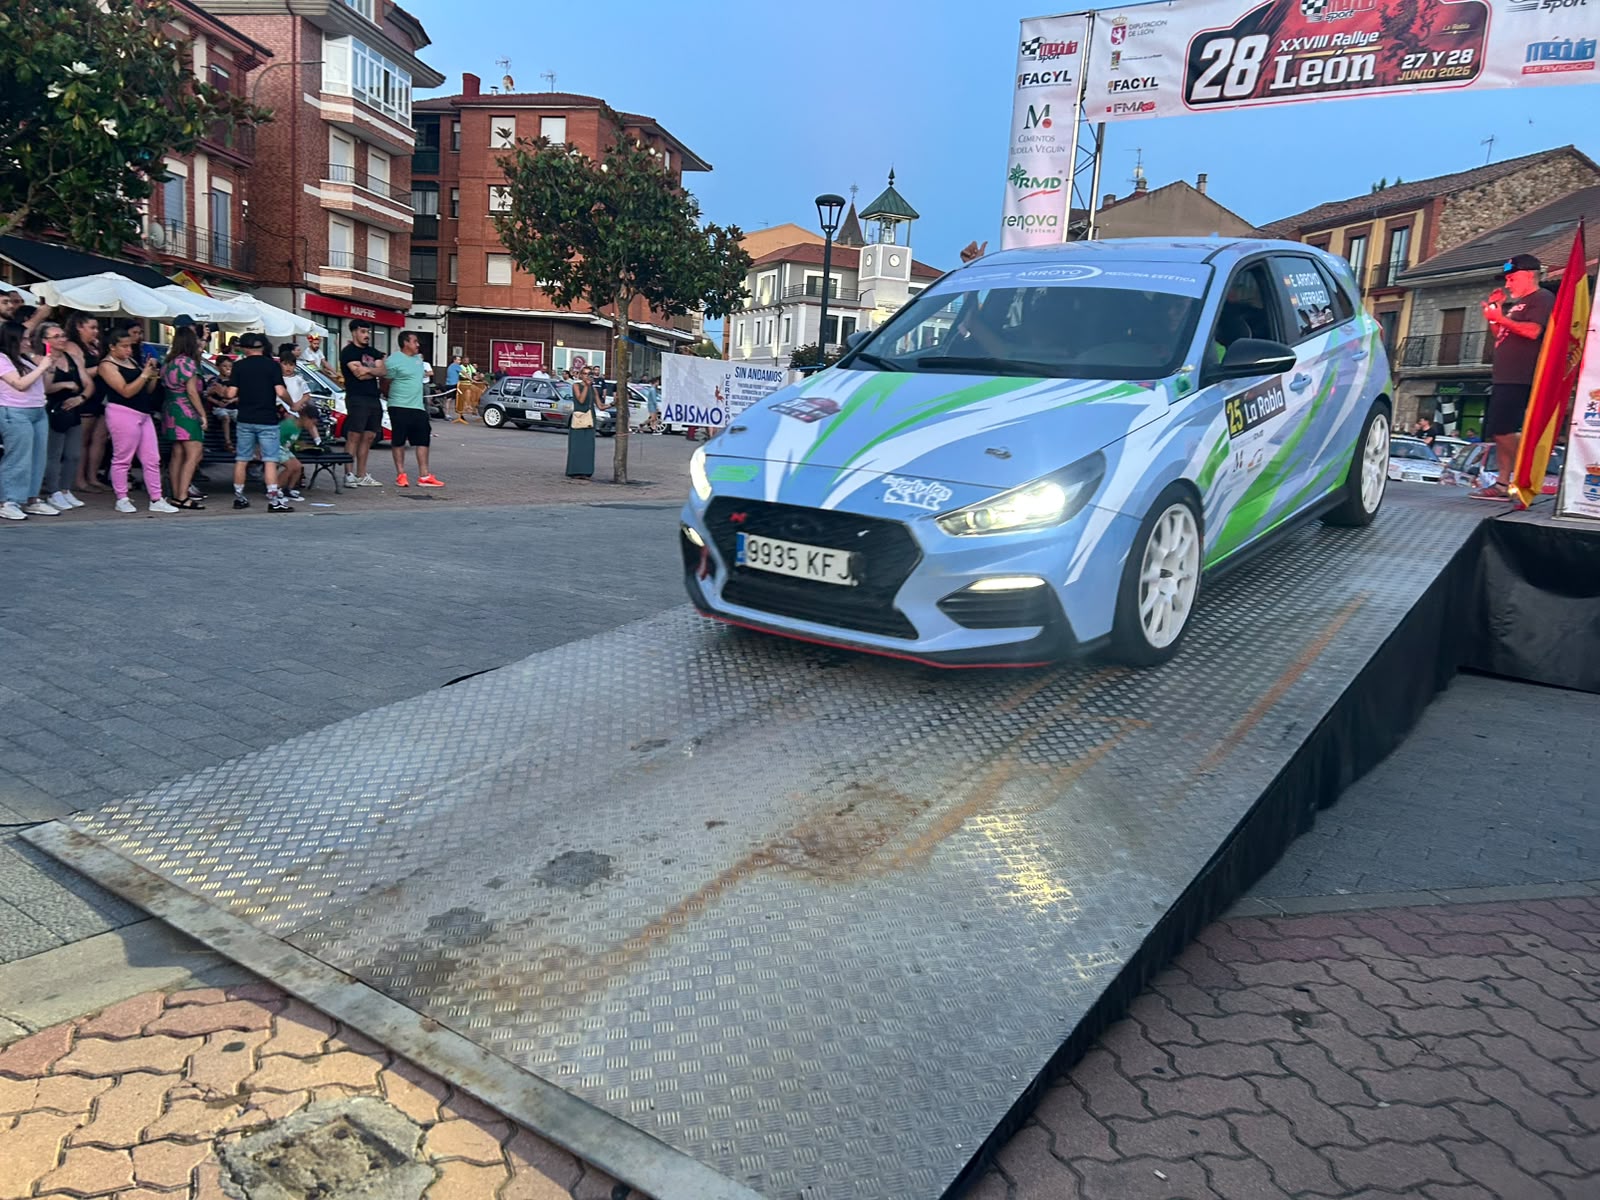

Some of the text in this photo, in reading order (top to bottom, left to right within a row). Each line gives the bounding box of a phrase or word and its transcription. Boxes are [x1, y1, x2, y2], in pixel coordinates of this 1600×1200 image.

[1326, 9, 1354, 22] sport
[1277, 31, 1380, 53] XXVIII Rallye
[1401, 48, 1475, 70] 27 Y 28
[1189, 34, 1270, 101] 28
[1269, 48, 1377, 90] León
[1397, 68, 1437, 81] JUNIO
[1525, 62, 1593, 73] SERVICIOS
[1022, 70, 1072, 86] FACYL
[1113, 76, 1159, 91] FACYL
[1113, 101, 1145, 113] FMA
[1019, 177, 1062, 189] RMD
[1002, 214, 1058, 230] renova
[1018, 268, 1083, 277] ARROYO
[350, 305, 376, 319] MAPFRE
[734, 366, 747, 379] SIN
[663, 403, 723, 425] ABISMO
[1226, 387, 1284, 435] 25 La Robla
[747, 539, 799, 571] 9935
